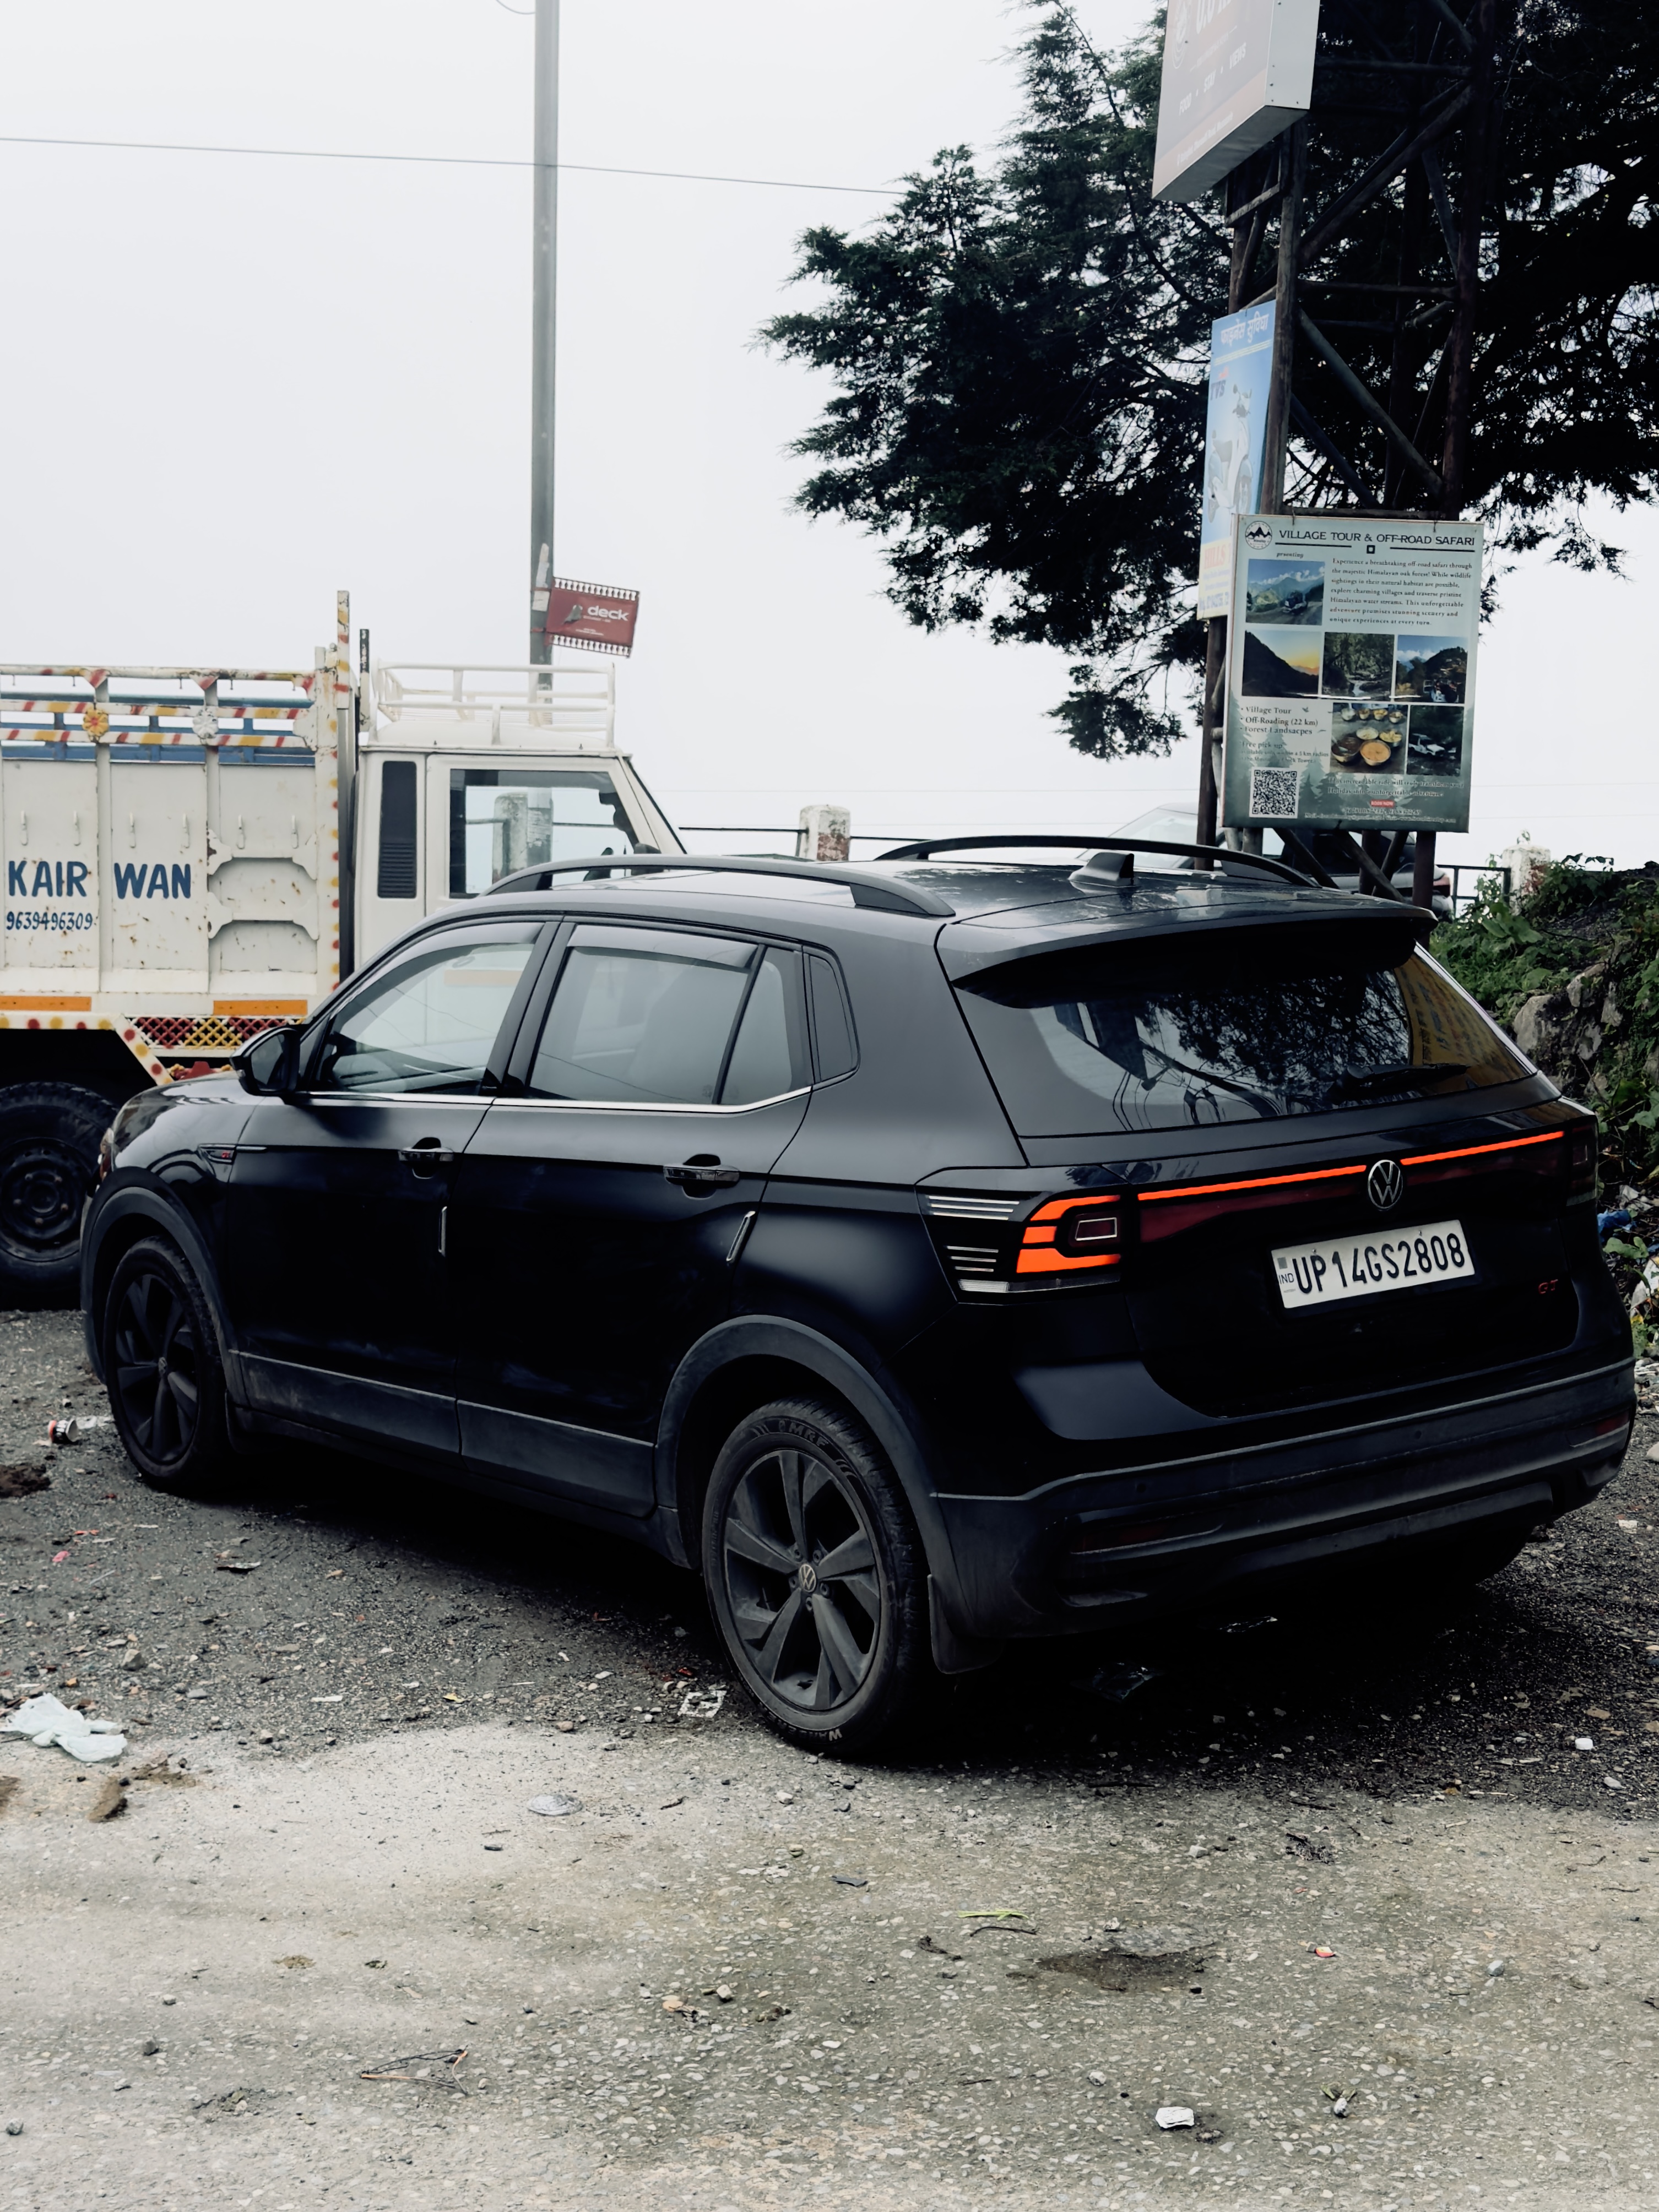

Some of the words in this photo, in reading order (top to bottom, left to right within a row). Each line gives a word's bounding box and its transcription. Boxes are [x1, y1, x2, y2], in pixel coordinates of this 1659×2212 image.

[1179, 93, 1192, 116] FOOD
[1203, 69, 1216, 93] STAY
[1229, 42, 1246, 69] VIEWS
[1210, 380, 1226, 400] TVS
[1279, 530, 1327, 540] VILLAGE
[1331, 532, 1361, 541] TOUR
[1364, 534, 1372, 542] &
[1376, 534, 1432, 544] OFF-ROAD
[1435, 536, 1475, 546] SAFARI
[1204, 545, 1226, 569] HILLS
[1332, 558, 1364, 568] Experience
[1449, 562, 1472, 570] through
[587, 605, 629, 621] deck
[1246, 706, 1272, 715] Village
[1245, 716, 1289, 726] Off-Roading
[8, 860, 88, 898] KAIR
[113, 862, 191, 900] WAN
[6, 911, 93, 931] 9639496309
[1292, 1232, 1465, 1294] UP14GS2808
[1278, 1273, 1294, 1285] IND
[1538, 1279, 1558, 1294] GT
[788, 1422, 829, 1446] MRF
